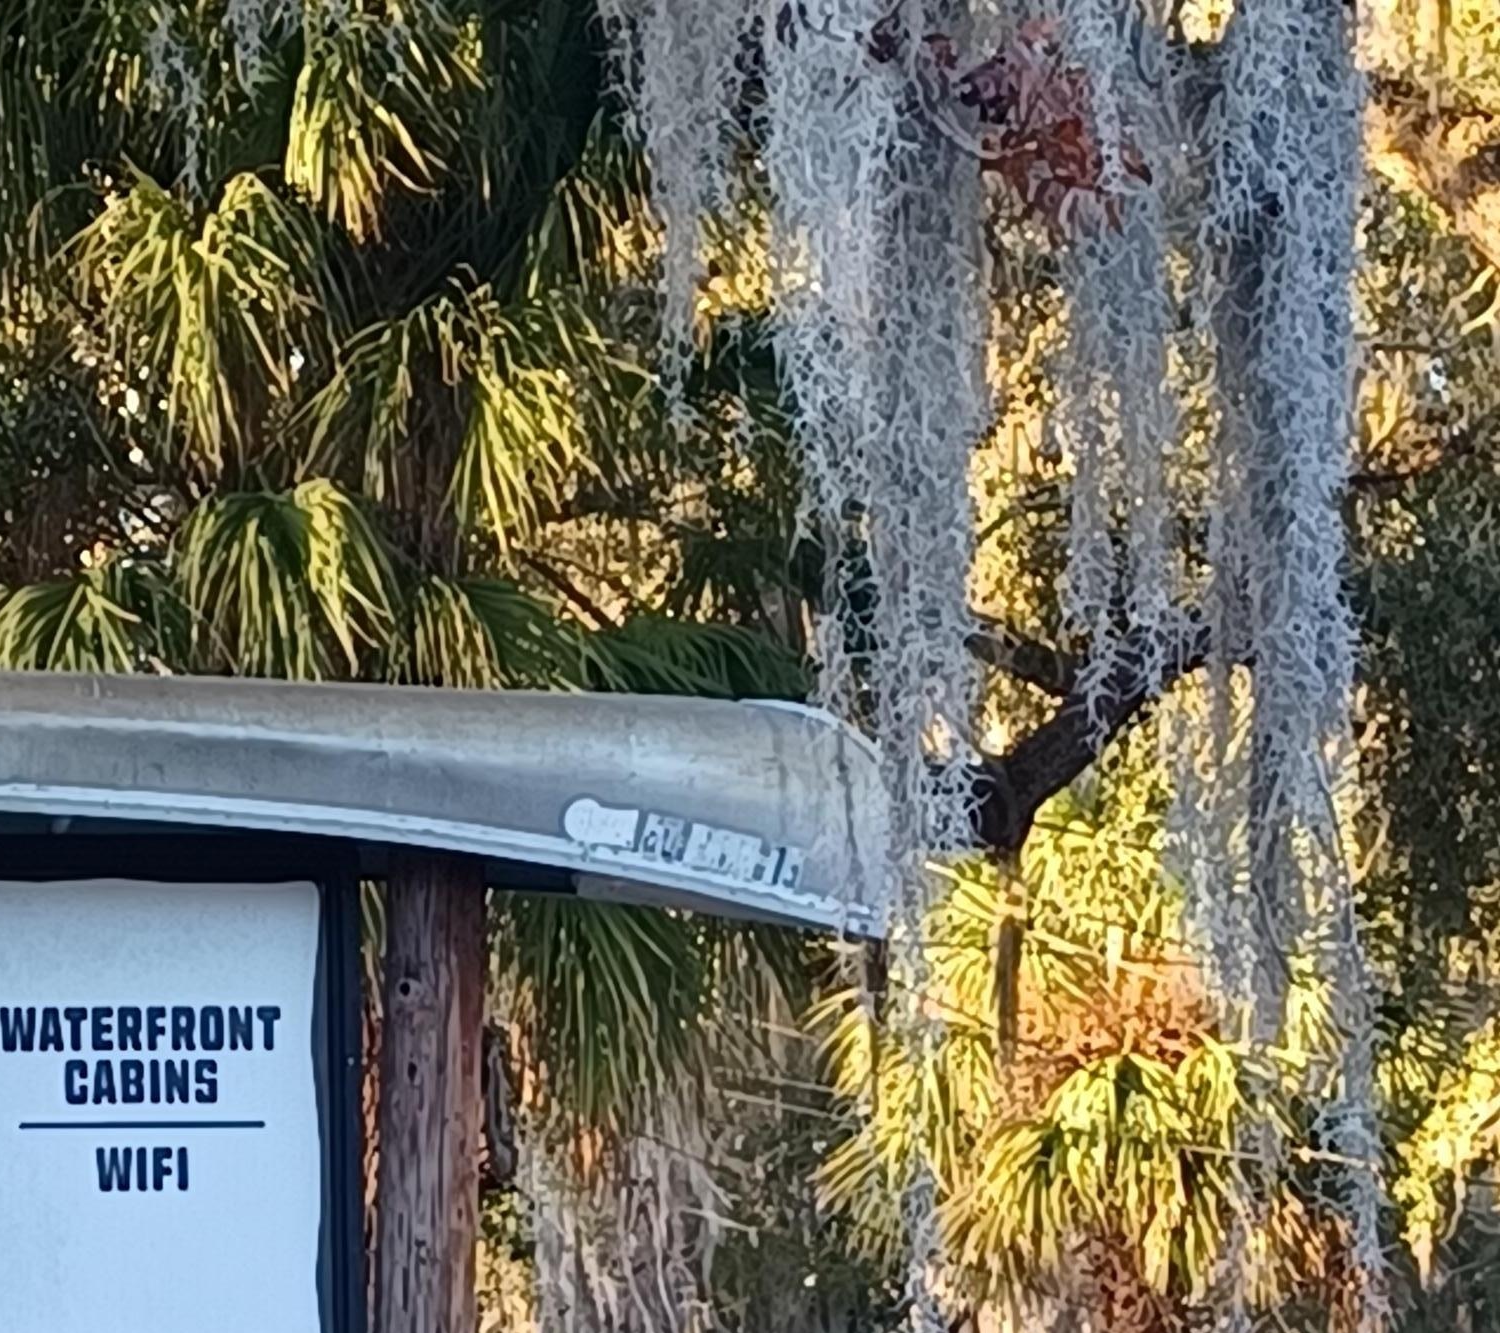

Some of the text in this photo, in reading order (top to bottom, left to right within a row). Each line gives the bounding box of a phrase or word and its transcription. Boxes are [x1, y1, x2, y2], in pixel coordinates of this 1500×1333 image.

[0, 1006, 281, 1052] WATERFRONT
[65, 1059, 217, 1104] CABINS
[96, 1147, 188, 1192] WIFI
